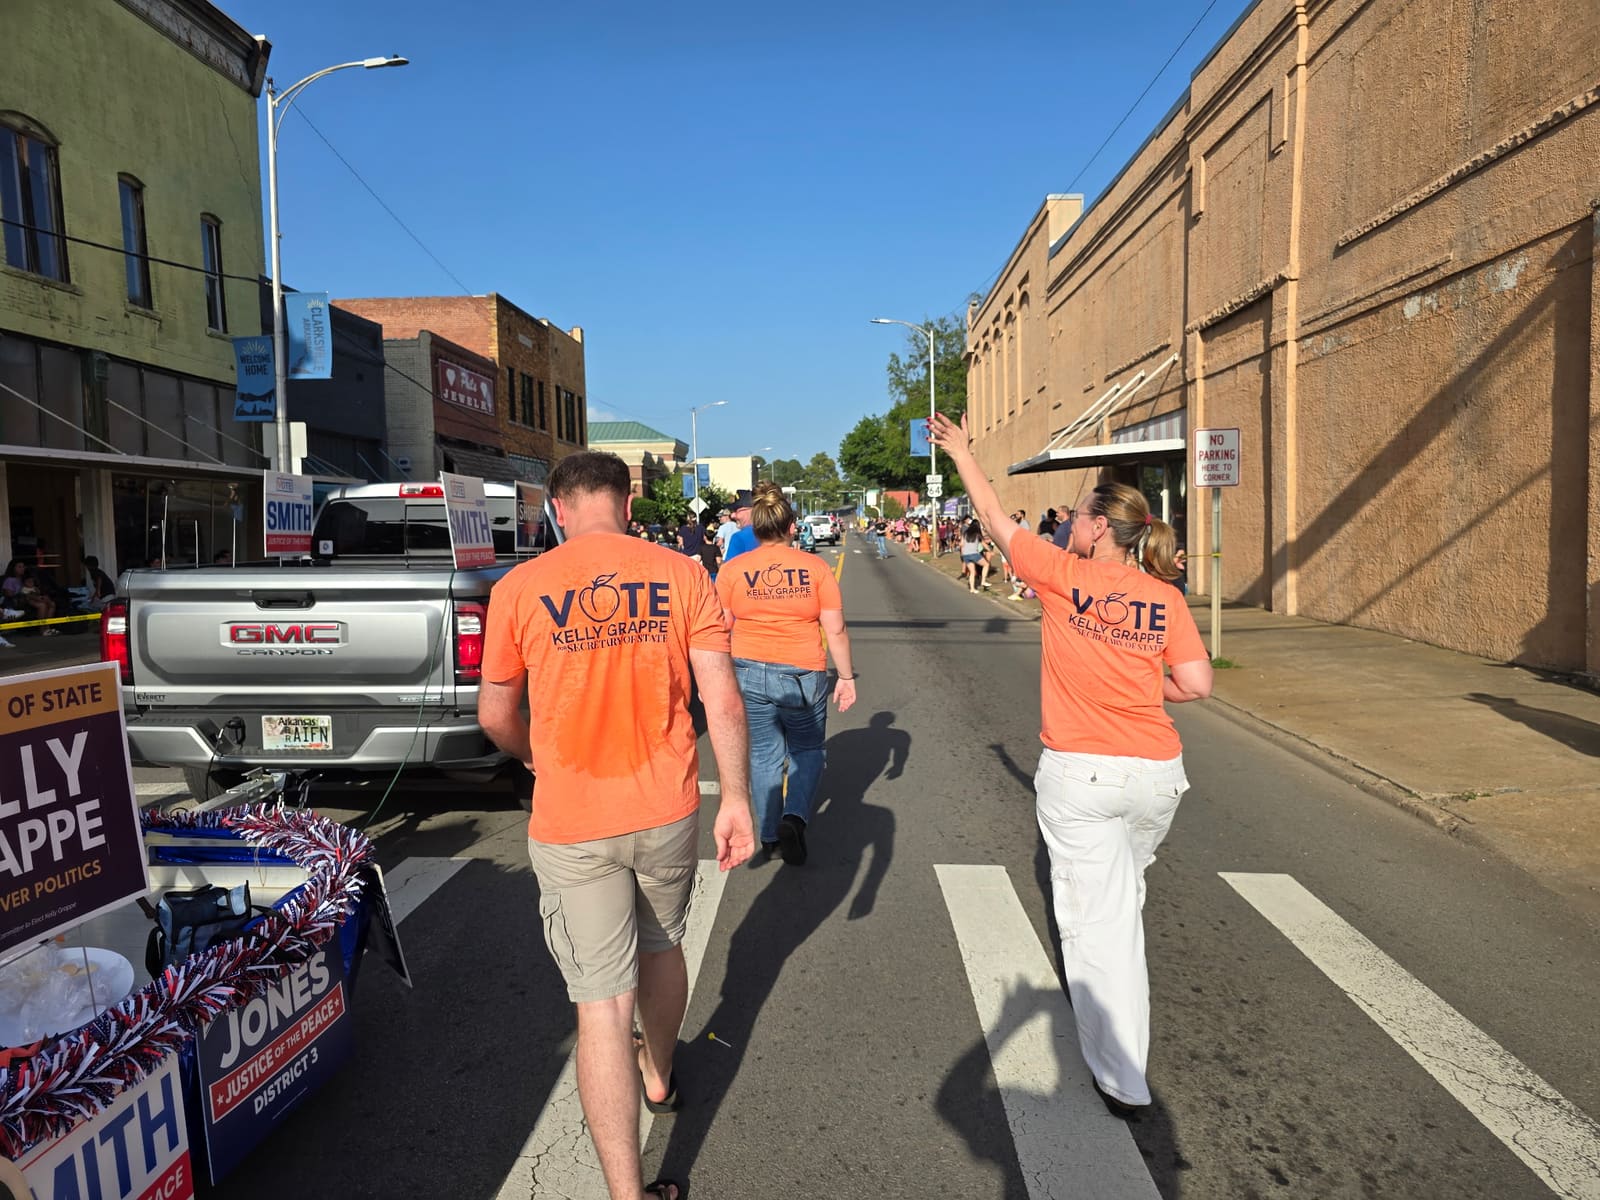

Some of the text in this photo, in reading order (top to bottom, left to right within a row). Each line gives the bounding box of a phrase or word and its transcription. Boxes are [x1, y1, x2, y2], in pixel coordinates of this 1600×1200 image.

[240, 355, 271, 364] WELCOME
[244, 364, 269, 376] HOME
[1209, 434, 1224, 446] NO
[1198, 449, 1236, 461] PARKING
[1201, 463, 1232, 472] HERE TO
[1203, 473, 1231, 482] CORNER
[928, 486, 940, 495] 64
[267, 501, 311, 531] SMITH
[449, 509, 492, 544] SMITH
[746, 586, 811, 597] KELLY GRAPPE
[230, 624, 340, 644] GMC
[552, 620, 668, 646] KELLY GRAPPE
[1069, 614, 1164, 645] KELLY GRAPPE
[1077, 628, 1123, 647] SECRETARY
[1125, 641, 1135, 649] OF
[567, 636, 622, 653] SECRETARY
[623, 635, 636, 644] OF
[637, 634, 668, 644] STATE
[8, 682, 103, 718] OF STATE
[278, 717, 316, 726] Arkansas
[34, 859, 102, 899] POLITICS
[220, 951, 330, 1069] JONES
[225, 1049, 274, 1104] JUSTICE
[274, 1043, 286, 1059] OF
[286, 1032, 301, 1050] THE
[301, 999, 334, 1039] PEACE
[254, 1054, 309, 1115] DISTRICT
[311, 1047, 319, 1064] 3
